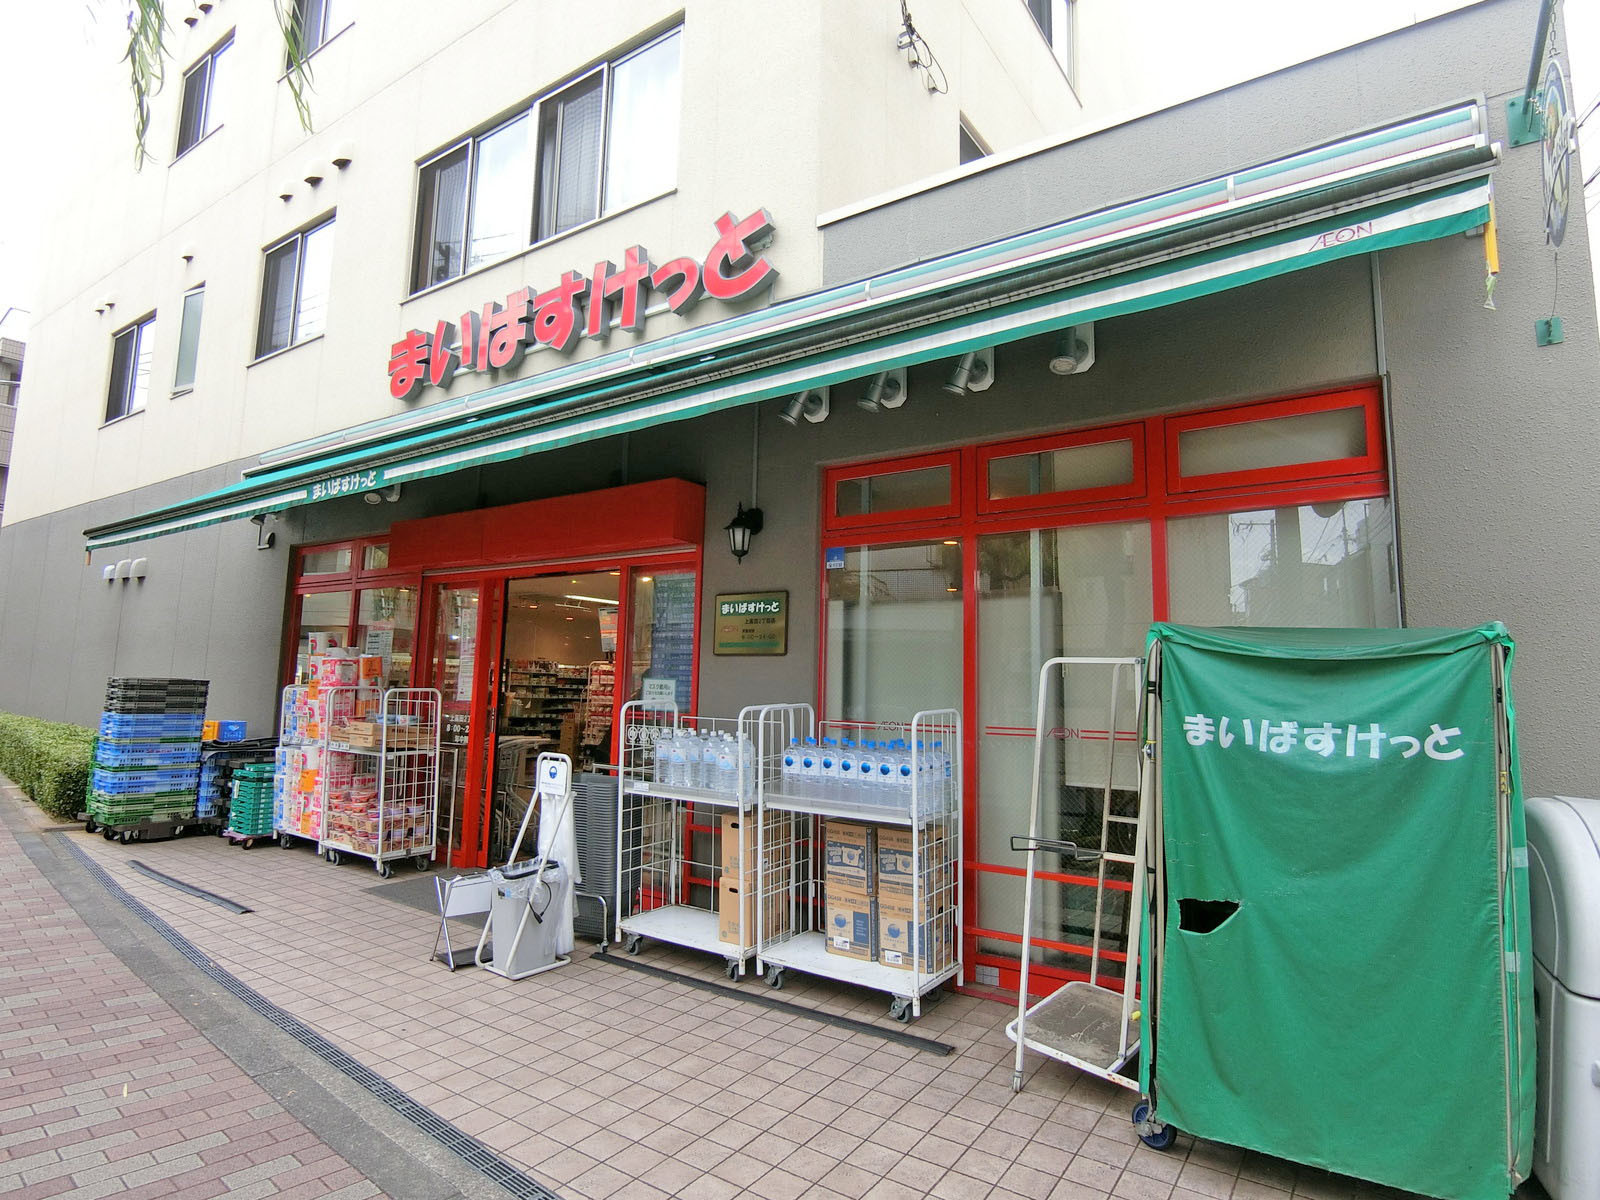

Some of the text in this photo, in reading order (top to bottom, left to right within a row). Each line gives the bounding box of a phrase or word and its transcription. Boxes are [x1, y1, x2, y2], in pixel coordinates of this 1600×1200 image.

[387, 207, 780, 400] まいばすけっと
[312, 470, 376, 500] まいばすけっと
[721, 601, 780, 615] まいばすけっと
[1182, 712, 1466, 762] まいばすけっと
